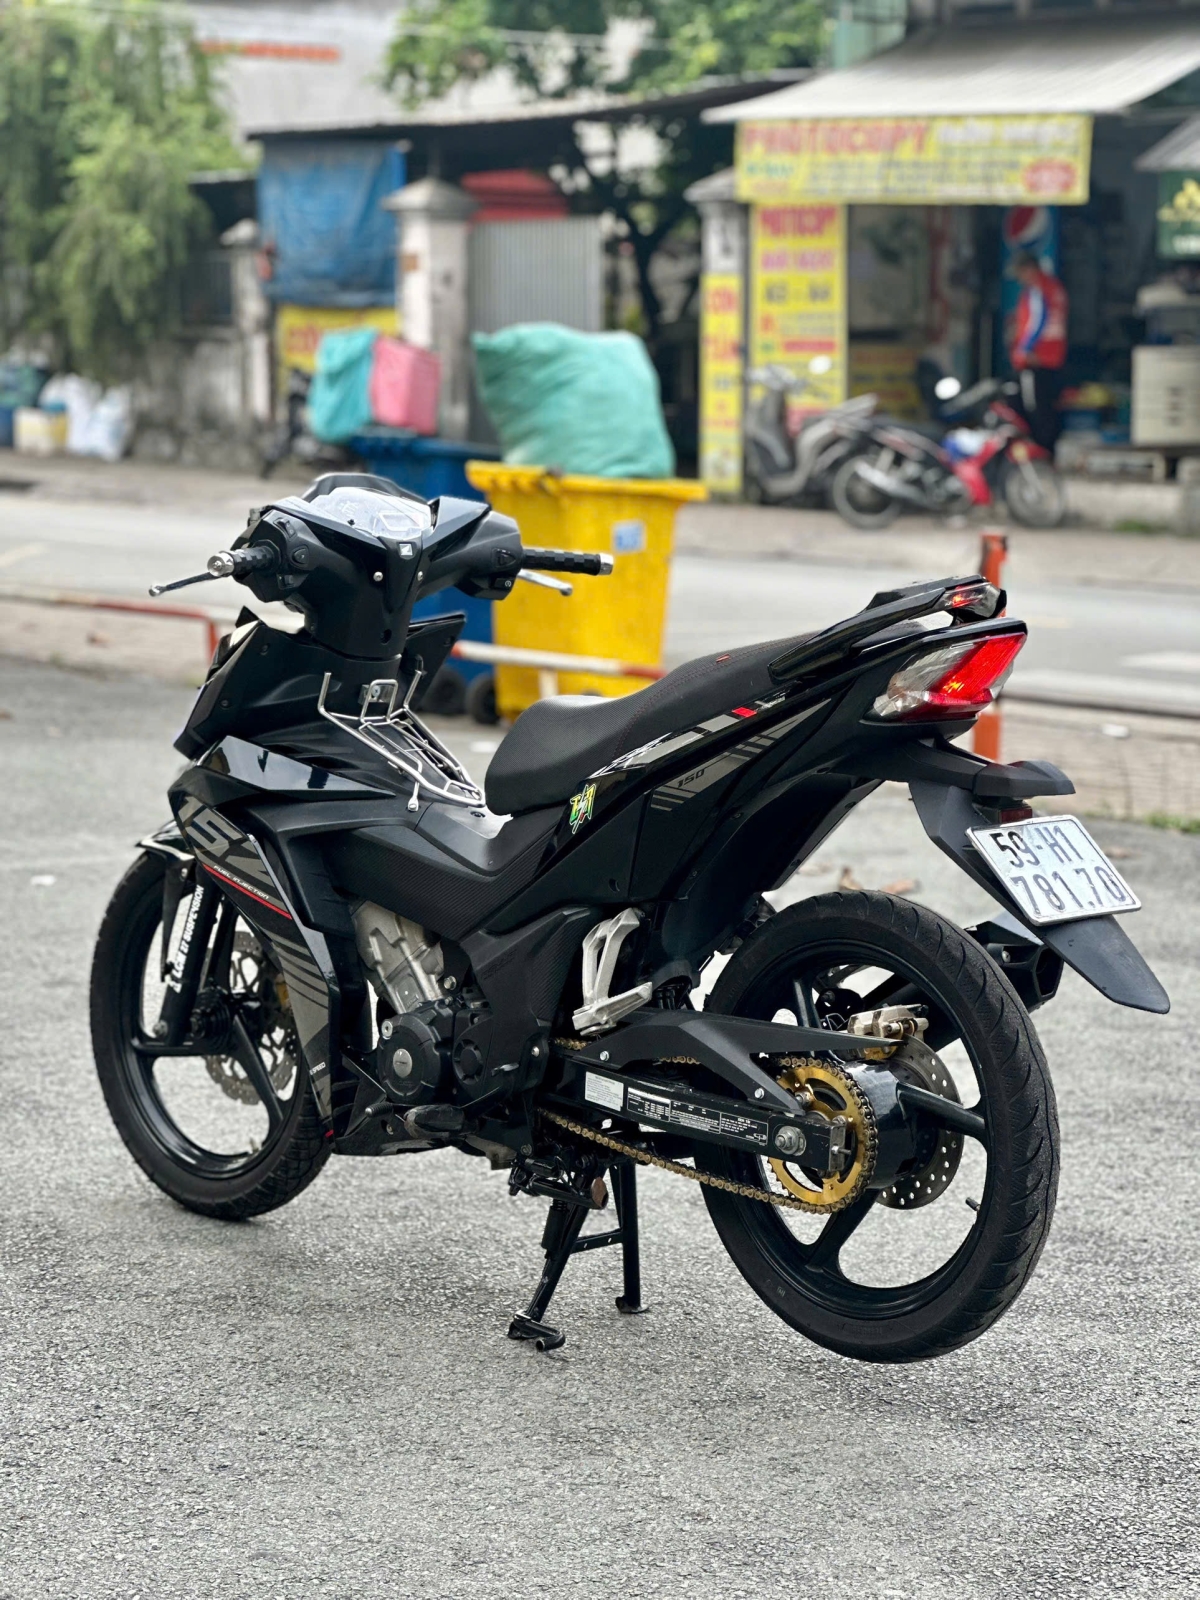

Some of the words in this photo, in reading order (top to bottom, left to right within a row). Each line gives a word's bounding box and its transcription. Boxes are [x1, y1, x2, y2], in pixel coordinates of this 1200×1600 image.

[677, 769, 706, 788] 150
[989, 825, 1084, 868] 59-H1
[213, 865, 231, 878] FUEL
[232, 876, 270, 900] INJECTION
[1010, 866, 1127, 915] 781.70
